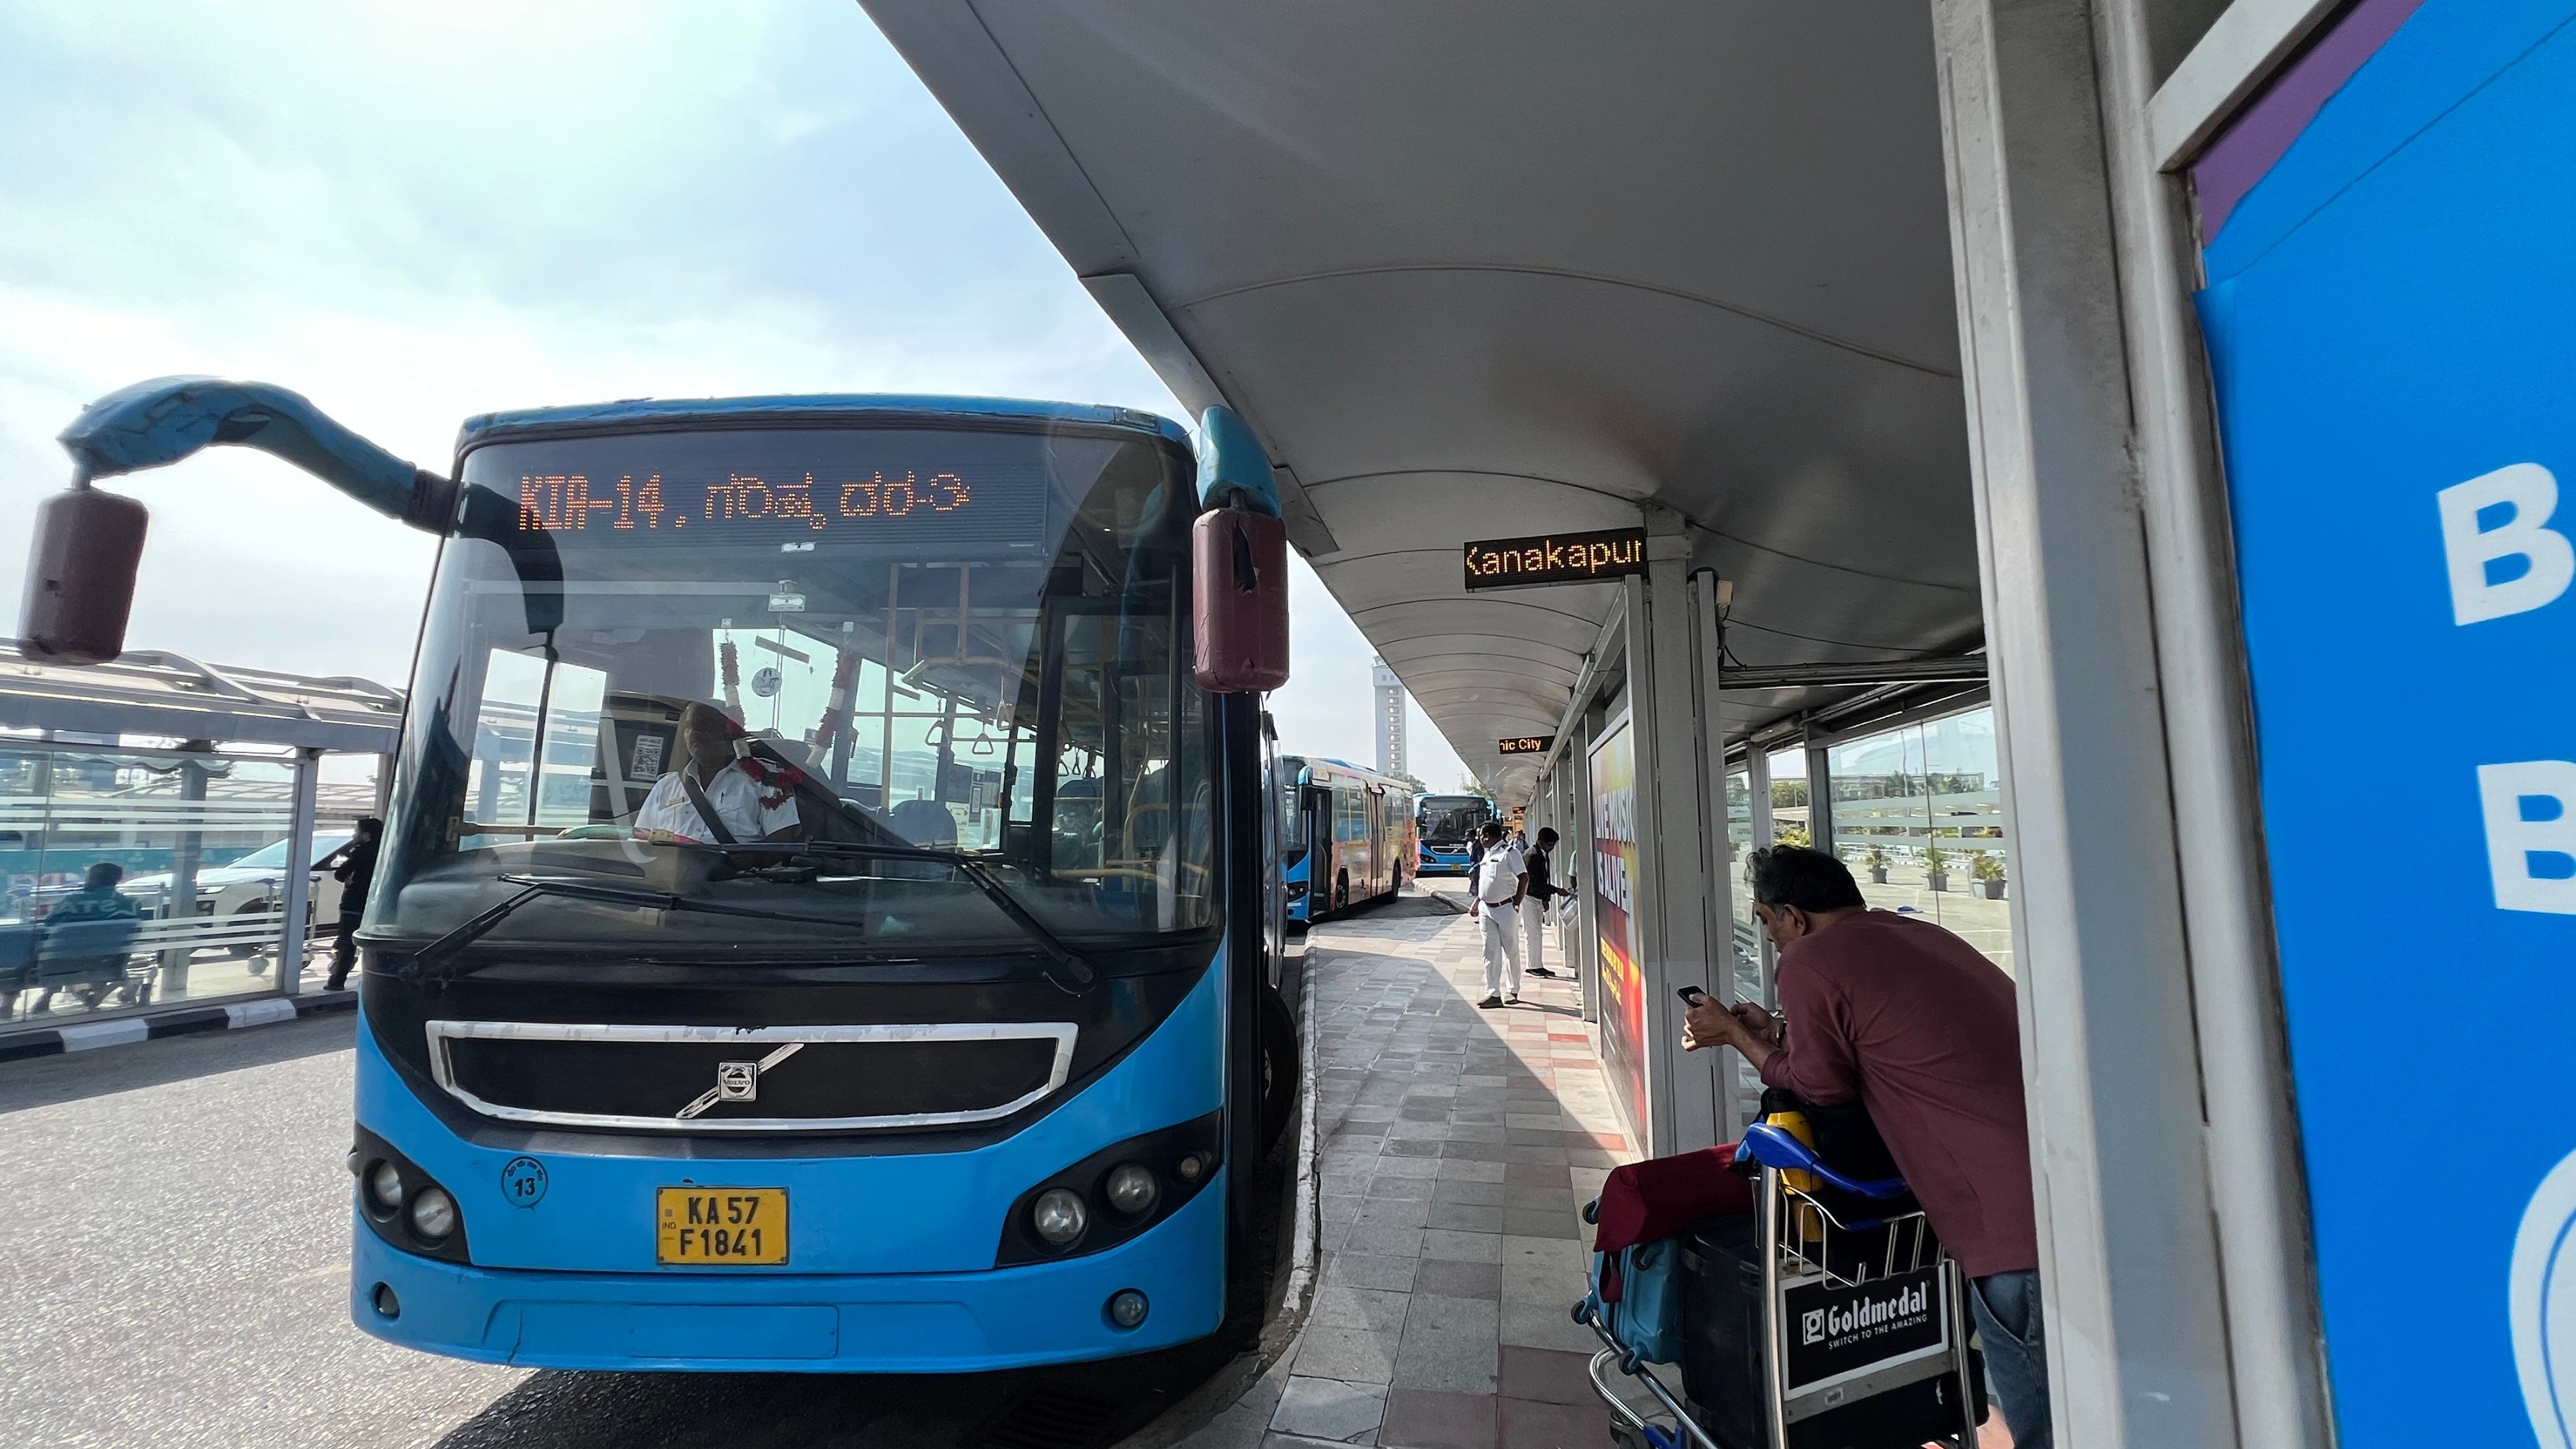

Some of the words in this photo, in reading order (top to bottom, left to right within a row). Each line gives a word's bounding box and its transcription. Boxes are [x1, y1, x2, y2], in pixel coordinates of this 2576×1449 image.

[1518, 738, 1541, 751] City
[1594, 792, 1611, 841] LIVE
[1608, 784, 1635, 844] MUSIC
[1596, 850, 1604, 896] IS
[514, 1177, 536, 1198] 13
[662, 1221, 676, 1229] IND
[687, 1196, 719, 1225] KA
[728, 1196, 760, 1225] 57
[680, 1228, 762, 1256] F1841
[1827, 1281, 1927, 1337] Goldmedal
[1828, 1333, 1859, 1350] SWITCH
[1861, 1329, 1872, 1339] TO
[1874, 1324, 1889, 1335] THE
[1891, 1313, 1927, 1330] AMAZING
